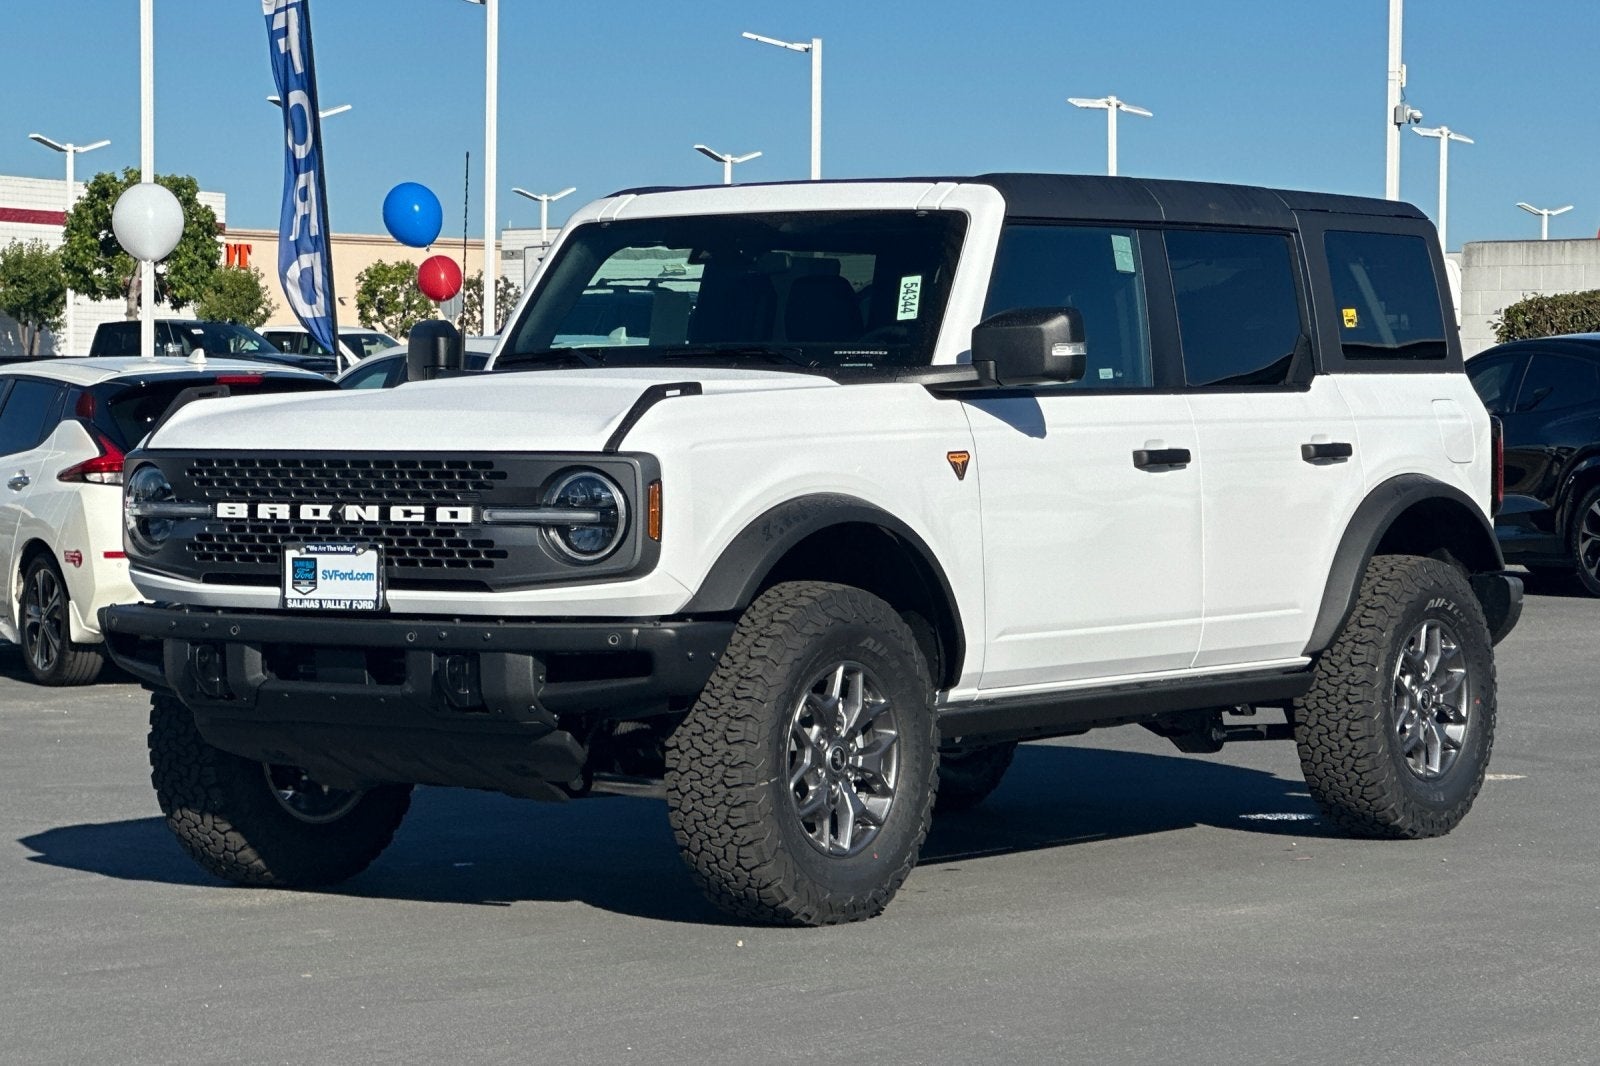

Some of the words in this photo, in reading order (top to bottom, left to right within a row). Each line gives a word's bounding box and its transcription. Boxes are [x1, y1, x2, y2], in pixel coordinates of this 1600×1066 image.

[901, 282, 918, 314] 54344
[216, 502, 472, 522] BRONCO
[322, 570, 374, 581] SVFord.com
[287, 599, 319, 608] SALINAS
[322, 600, 350, 609] VALLEY
[353, 601, 374, 609] FORD
